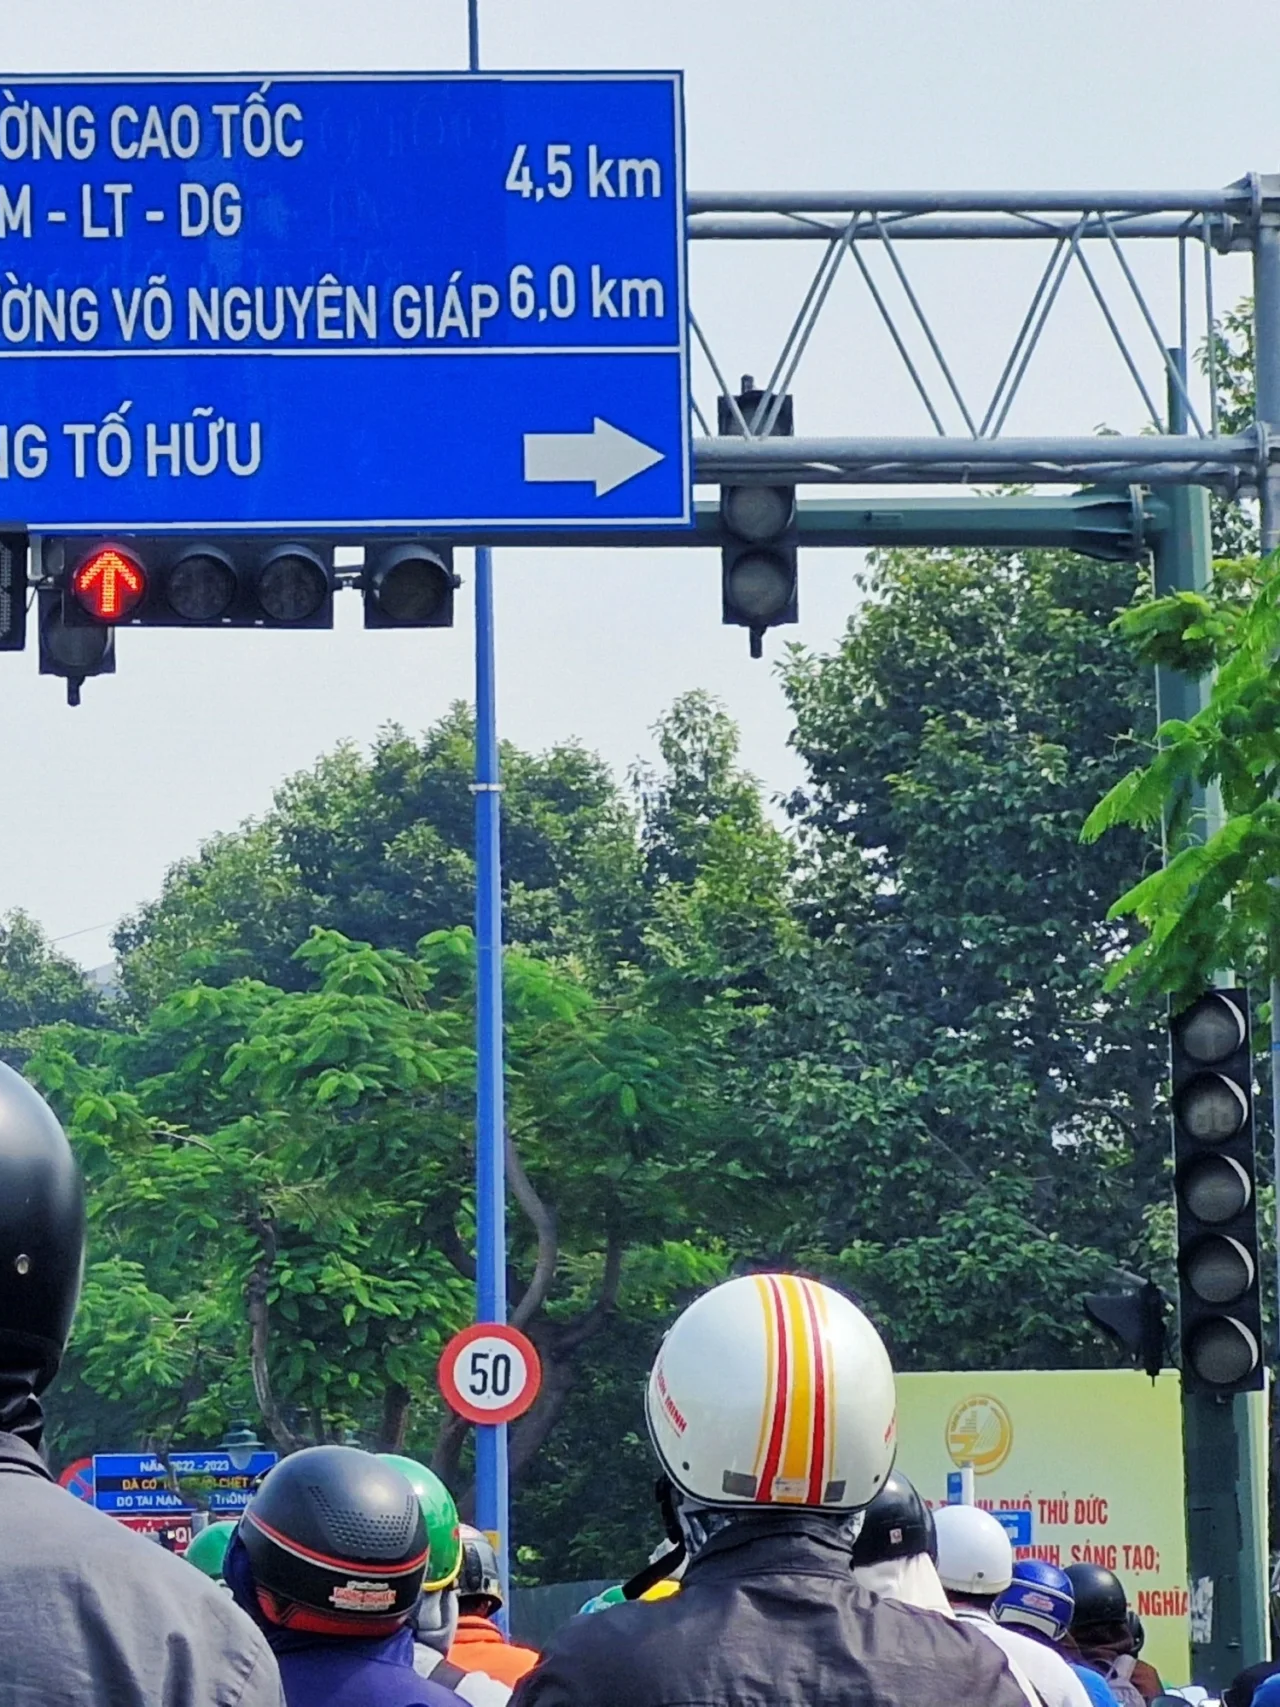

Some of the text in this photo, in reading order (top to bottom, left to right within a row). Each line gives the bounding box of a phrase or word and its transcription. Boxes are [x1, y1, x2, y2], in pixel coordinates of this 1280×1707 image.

[111, 104, 200, 160] CAO
[212, 83, 303, 158] TỐC
[505, 144, 661, 202] 4,5 km
[82, 183, 133, 238] LT
[180, 182, 241, 237] DG
[111, 274, 172, 341] VÕ
[188, 273, 377, 341] NGUYÊN
[393, 271, 499, 339] GIÁP
[510, 265, 576, 321] 6,0
[591, 265, 664, 318] km
[63, 400, 132, 478] TỐ
[146, 406, 261, 477] HỮU
[469, 1352, 511, 1396] 50
[116, 1495, 134, 1508] DO
[1037, 1490, 1069, 1525] THỦ
[1074, 1492, 1108, 1525] ĐỨC
[1071, 1538, 1117, 1570] SÁNG
[1122, 1544, 1160, 1576] TẠO;
